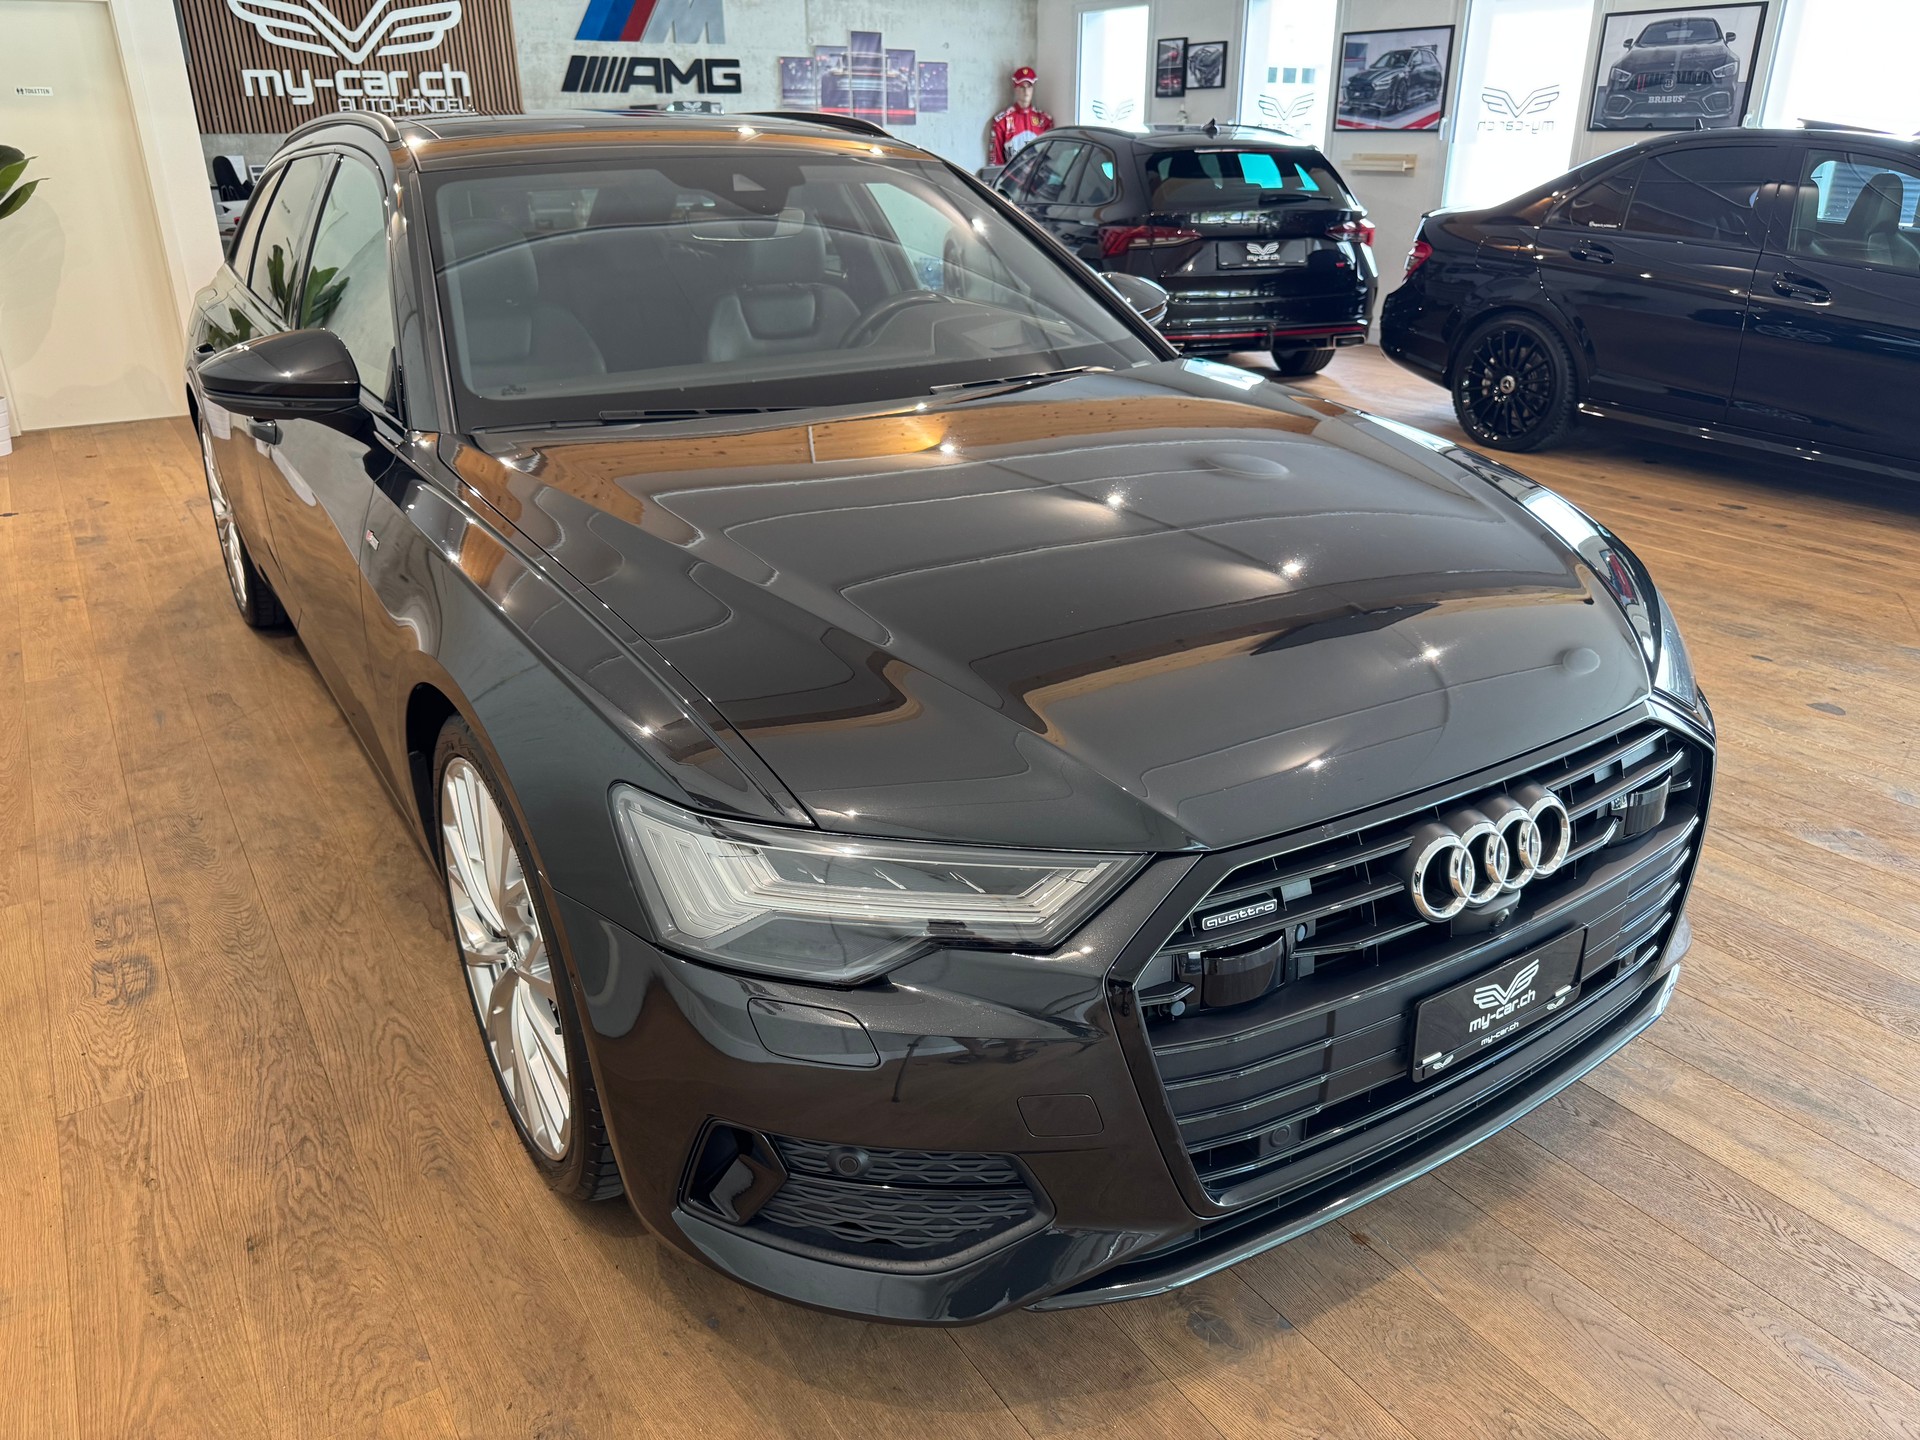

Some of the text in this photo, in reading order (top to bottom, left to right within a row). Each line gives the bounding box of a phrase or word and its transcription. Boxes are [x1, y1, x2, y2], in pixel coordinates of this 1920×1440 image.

[241, 63, 471, 106] my-car.ch
[619, 56, 742, 94] AMG
[338, 98, 469, 113] AUTOHANDEL
[1648, 95, 1684, 103] BRABUS
[1206, 903, 1275, 927] quattro
[1468, 989, 1537, 1033] my-car.ch
[1480, 1021, 1520, 1046] my-car.ch
